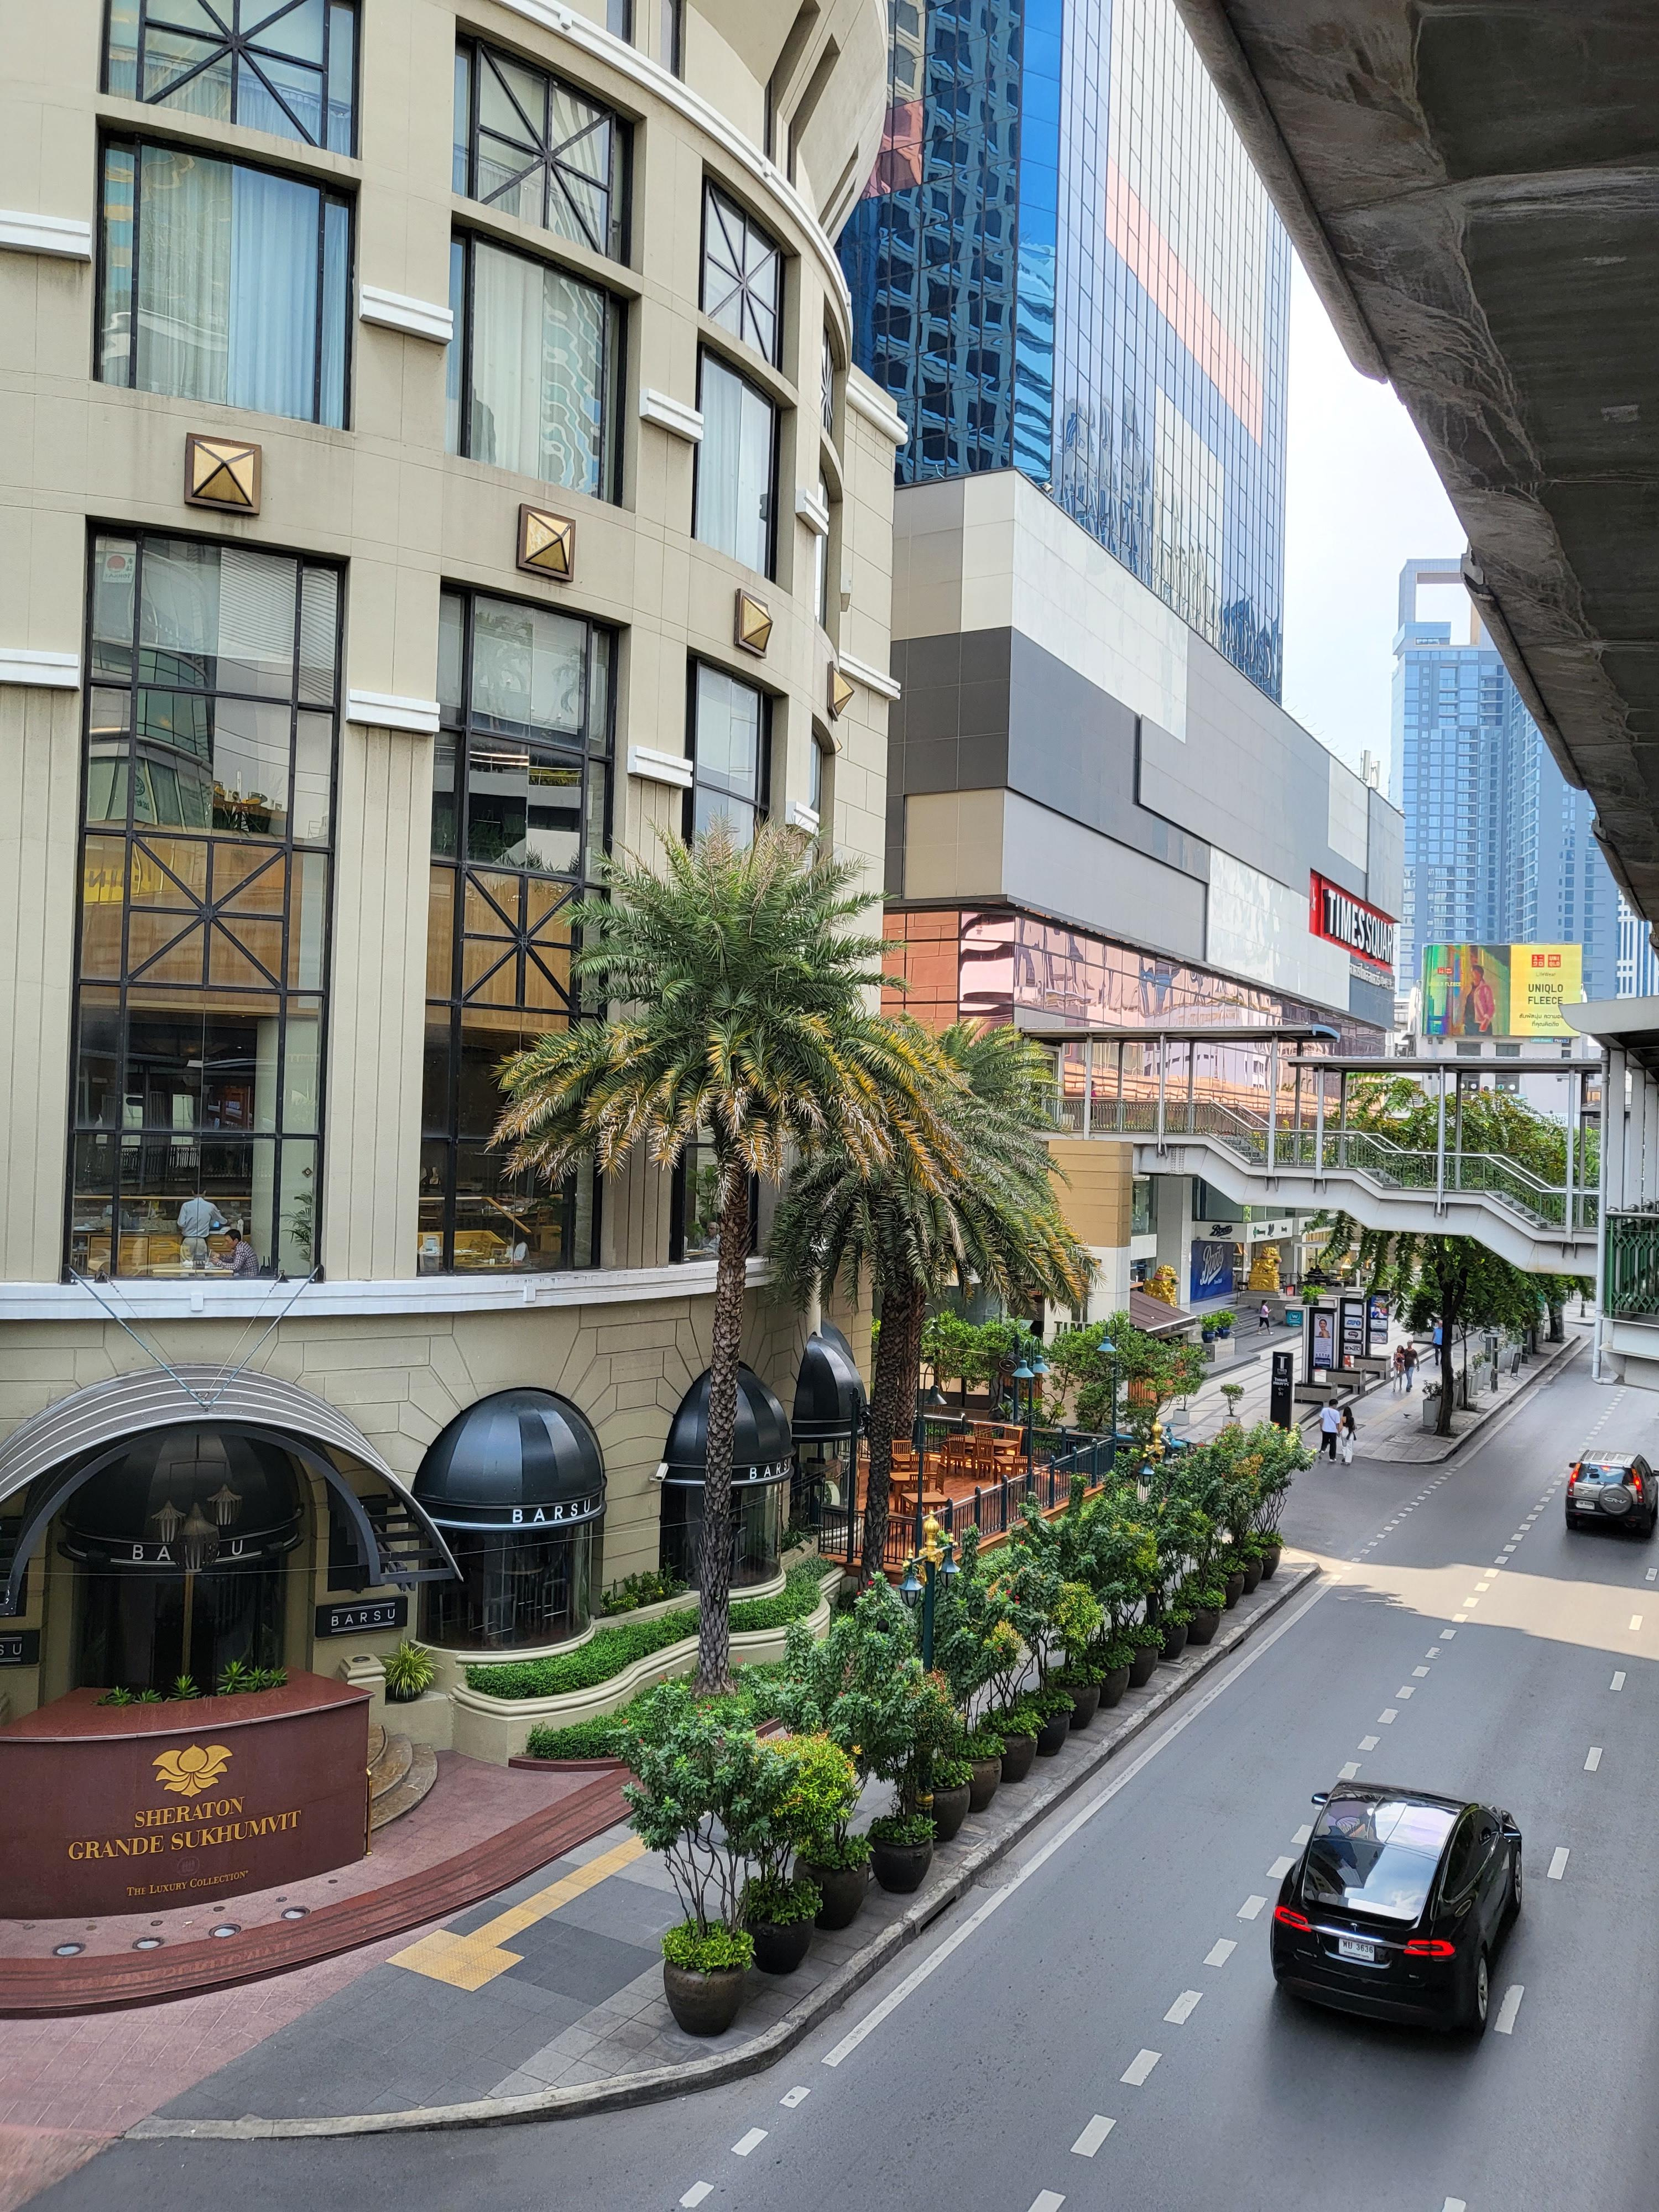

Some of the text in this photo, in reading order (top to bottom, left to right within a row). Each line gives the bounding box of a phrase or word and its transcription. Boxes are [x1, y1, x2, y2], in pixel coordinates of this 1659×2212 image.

[1328, 889, 1365, 950] TIMES
[1528, 984, 1563, 994] UNIQLO
[1528, 997, 1563, 1005] FLEECE
[1209, 1224, 1232, 1237] Boots
[1200, 1244, 1224, 1286] Boots
[512, 1499, 590, 1524] BARSU
[132, 1539, 243, 1561] BAU
[331, 1608, 395, 1626] BARSU
[134, 1796, 245, 1828] SHERATON
[68, 1809, 302, 1860] GRANDE SUKHUMVIT
[126, 1870, 246, 1897] THE LUXURY COLLECTION
[1356, 1943, 1374, 1953] 3636
